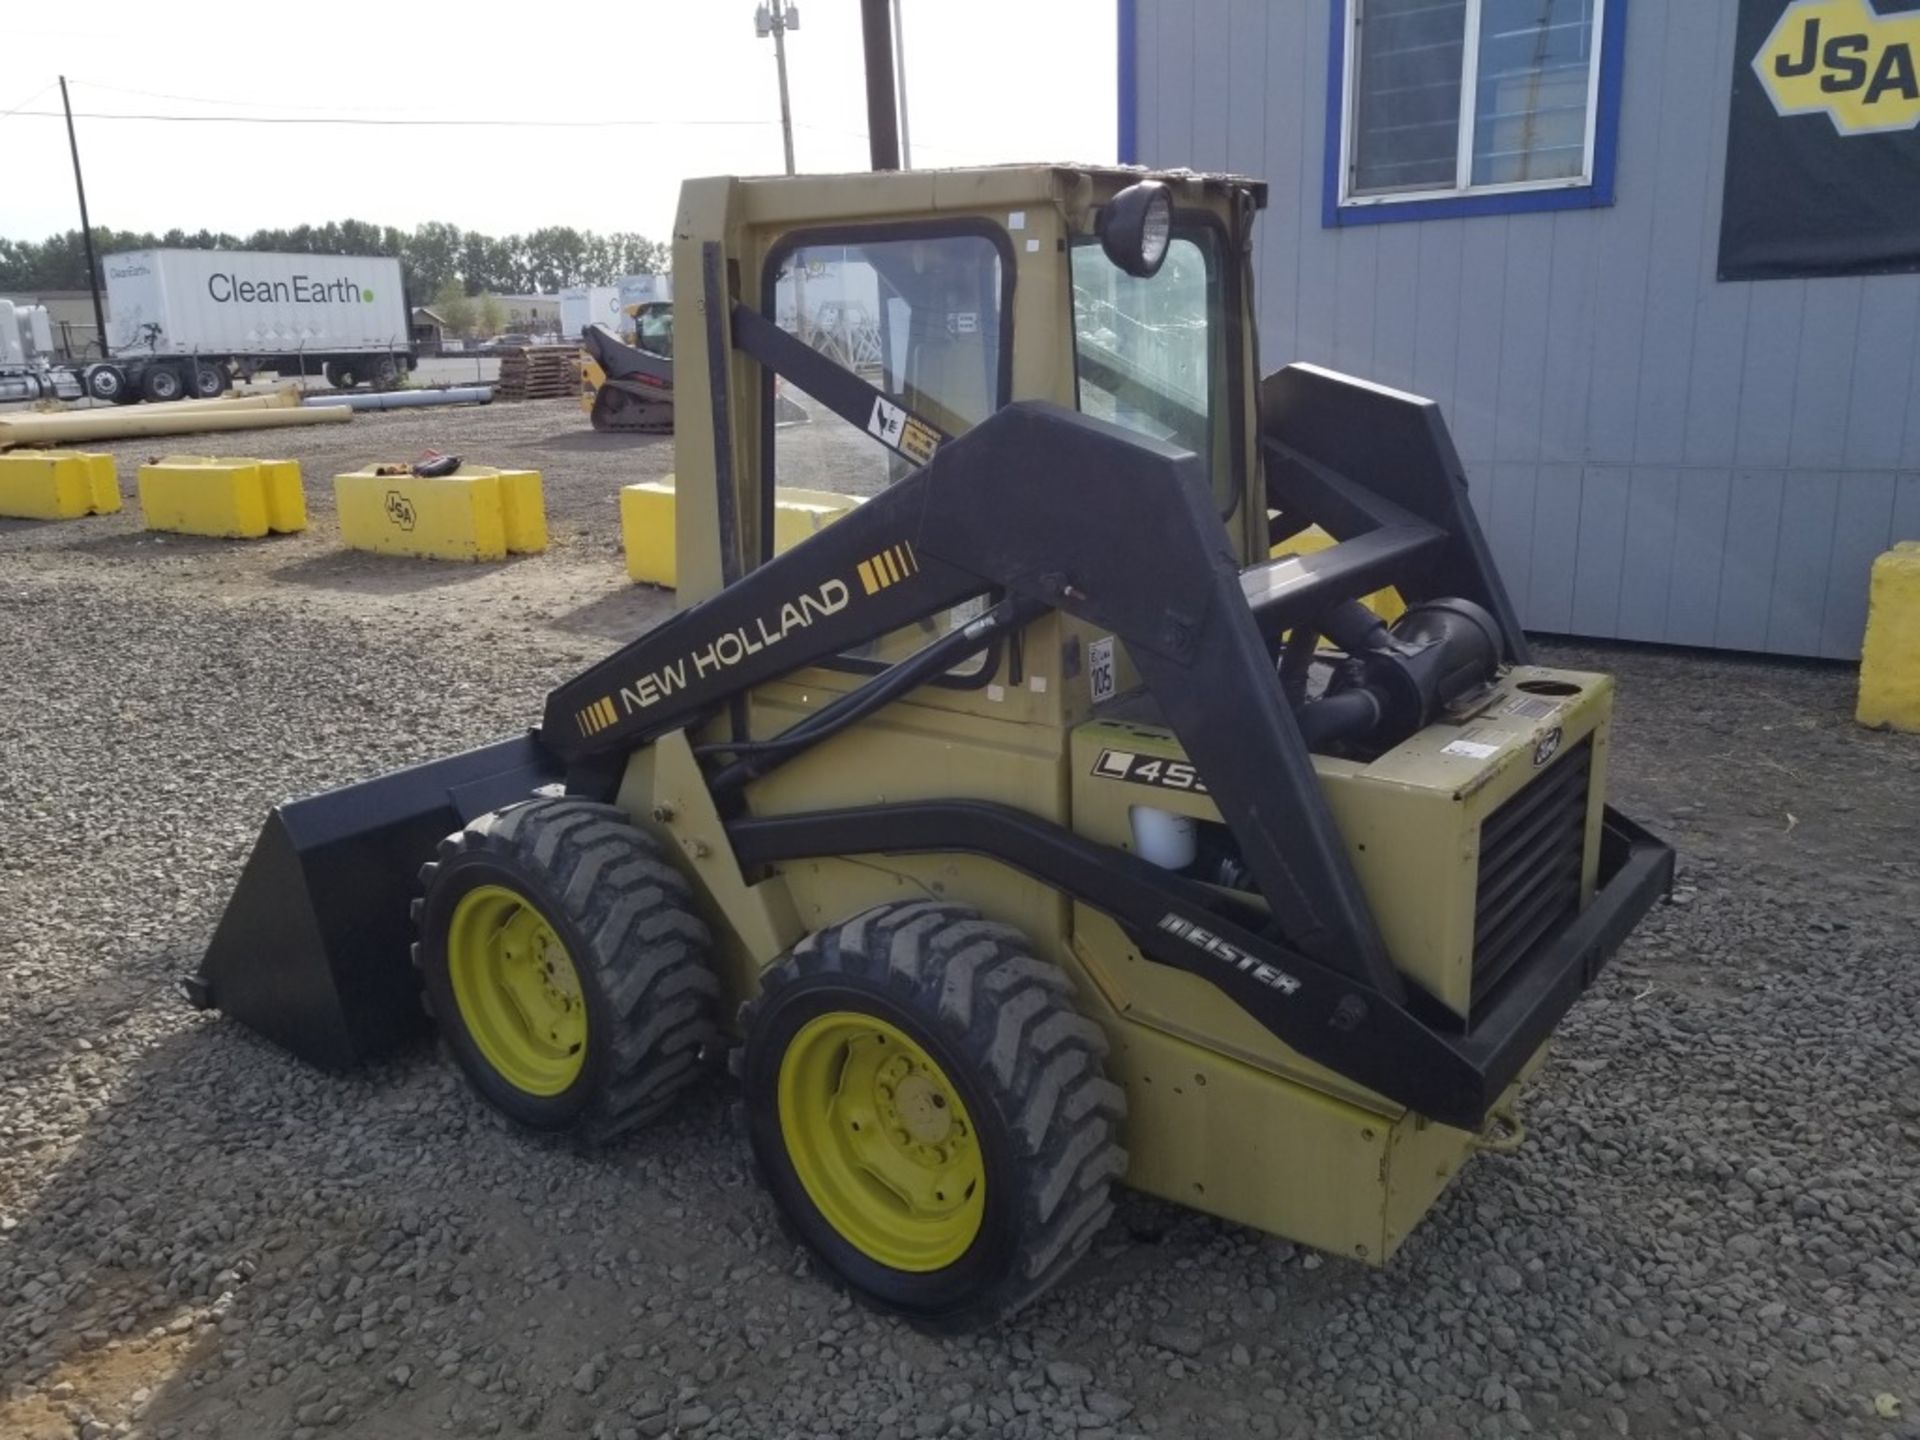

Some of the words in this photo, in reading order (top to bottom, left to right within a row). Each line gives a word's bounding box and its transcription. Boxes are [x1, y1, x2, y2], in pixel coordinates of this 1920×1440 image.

[1775, 18, 1920, 105] JSA
[388, 496, 411, 524] JSA
[620, 659, 686, 714] NEW
[692, 578, 849, 679] HOLLAND
[1091, 664, 1112, 697] 105
[1134, 760, 1208, 792] 45
[1157, 911, 1302, 995] MEISTER
